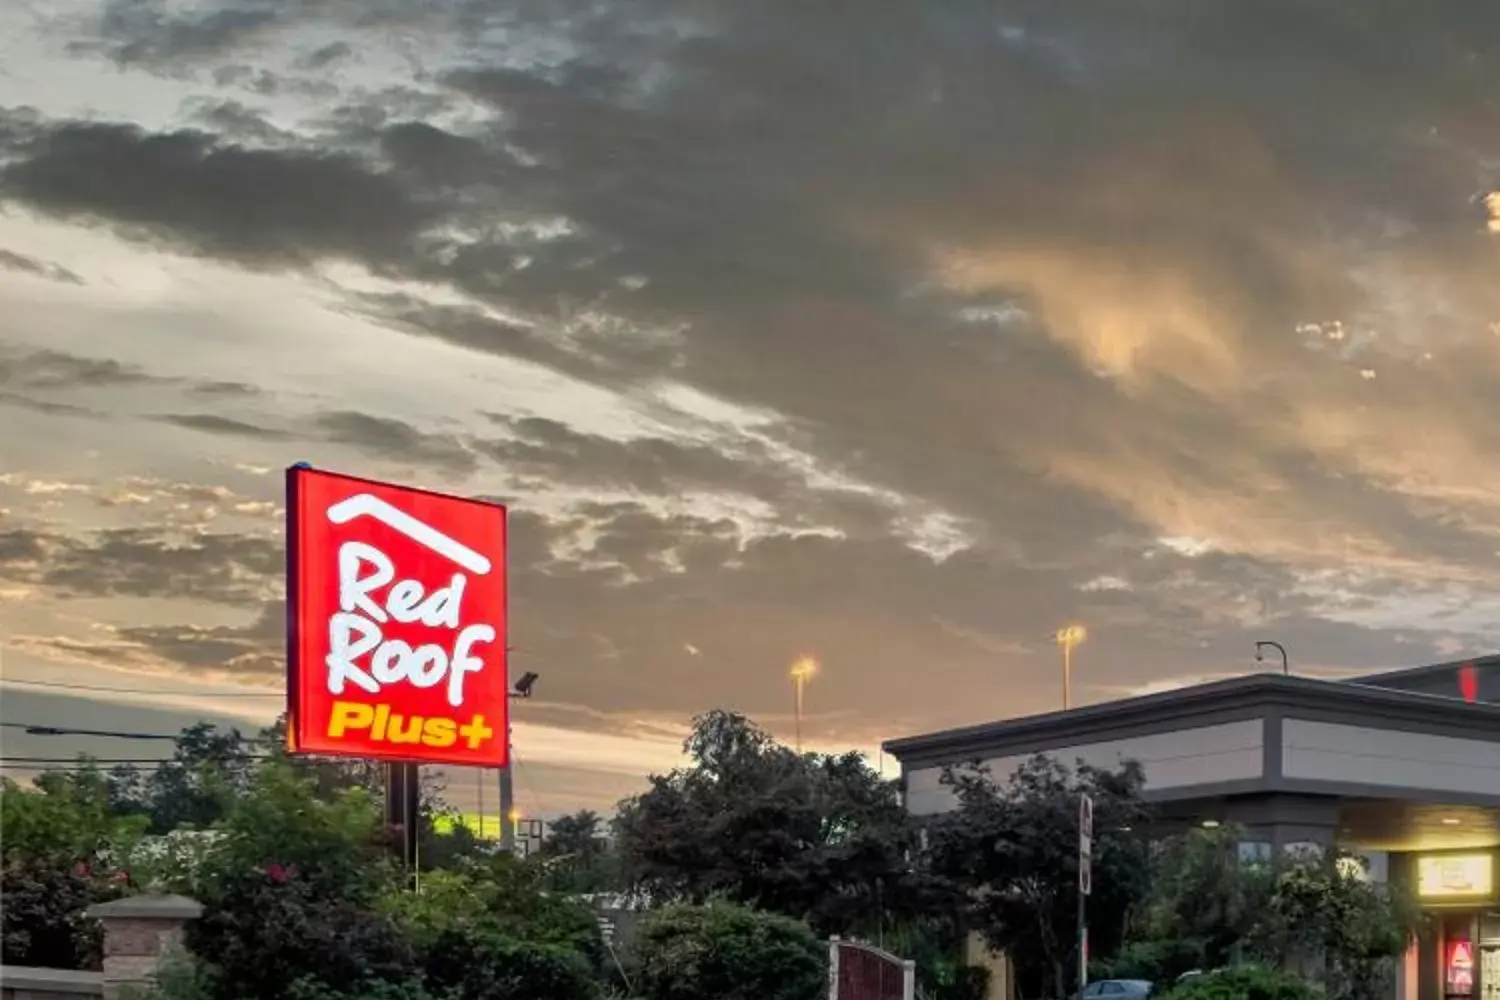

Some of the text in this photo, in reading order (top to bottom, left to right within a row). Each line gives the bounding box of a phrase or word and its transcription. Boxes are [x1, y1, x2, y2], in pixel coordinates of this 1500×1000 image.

[339, 541, 467, 628] Red
[325, 612, 496, 707] Roof
[327, 701, 493, 749] Plus+
